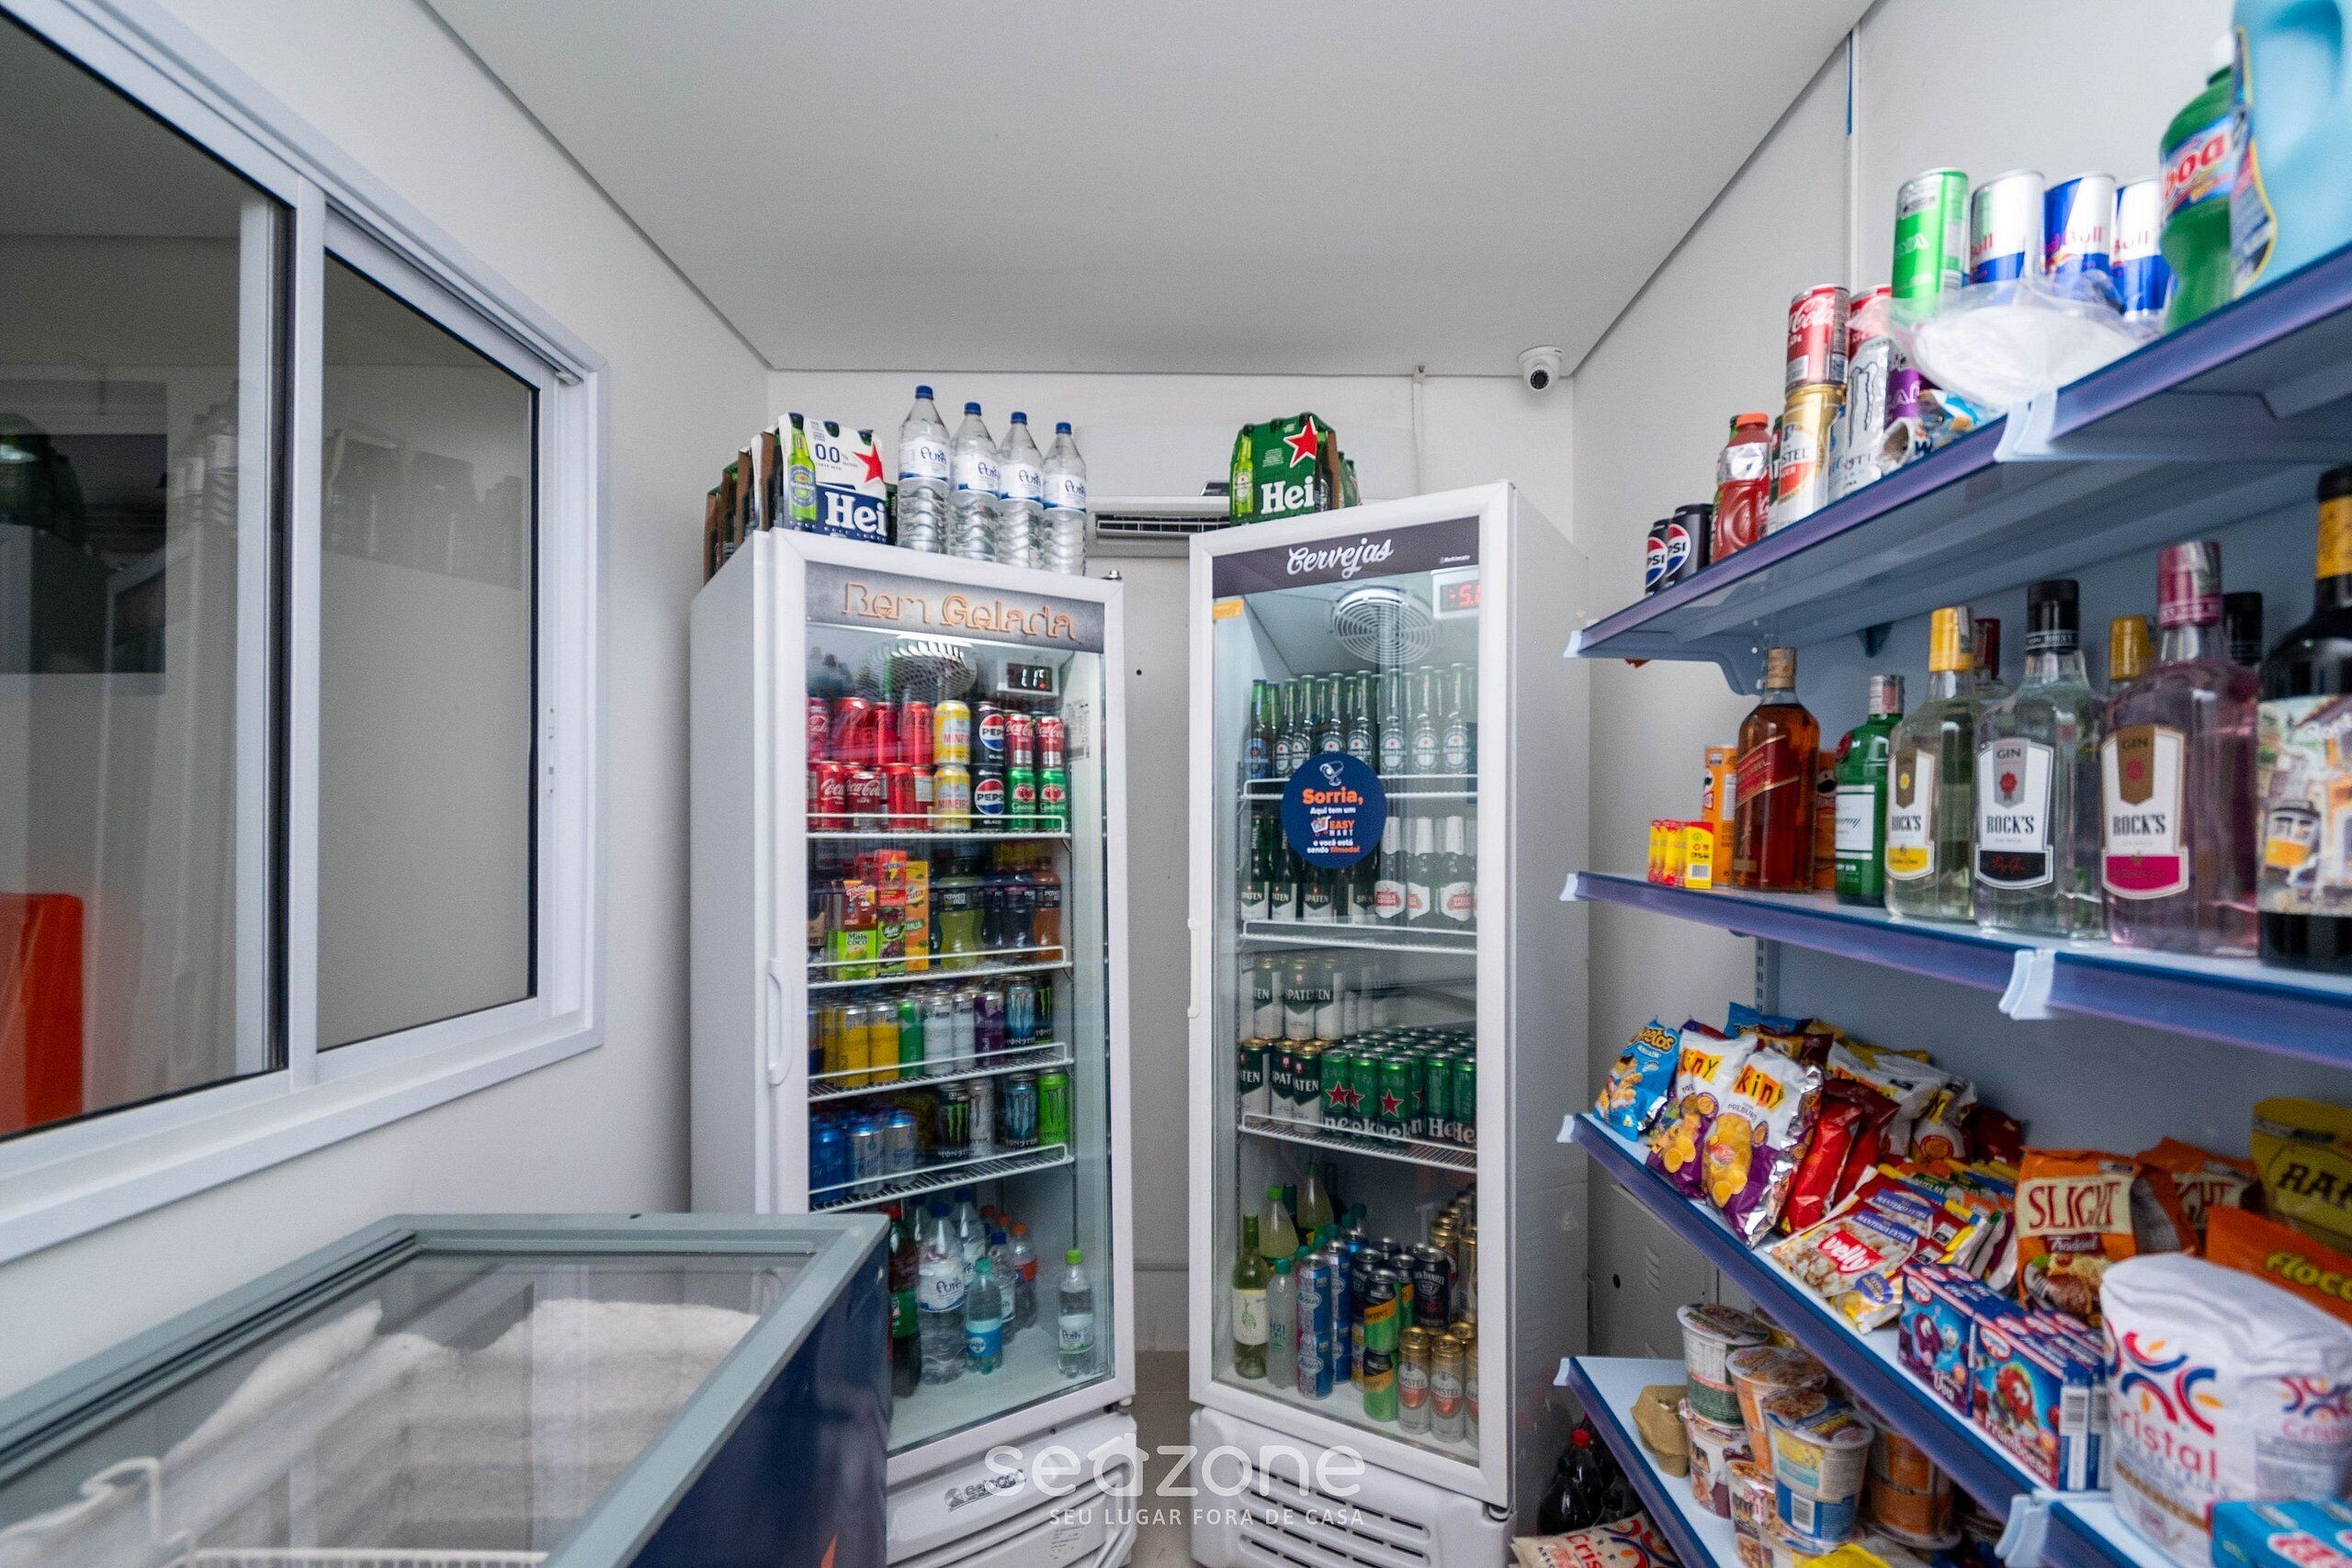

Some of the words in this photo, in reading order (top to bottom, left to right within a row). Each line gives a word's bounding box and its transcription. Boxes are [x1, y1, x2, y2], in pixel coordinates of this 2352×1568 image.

[1286, 538, 1395, 580] Cervejas
[1302, 786, 1364, 806] Sorria,
[1986, 815, 2035, 835] ROCK'S
[2113, 813, 2166, 837] ROCK'S
